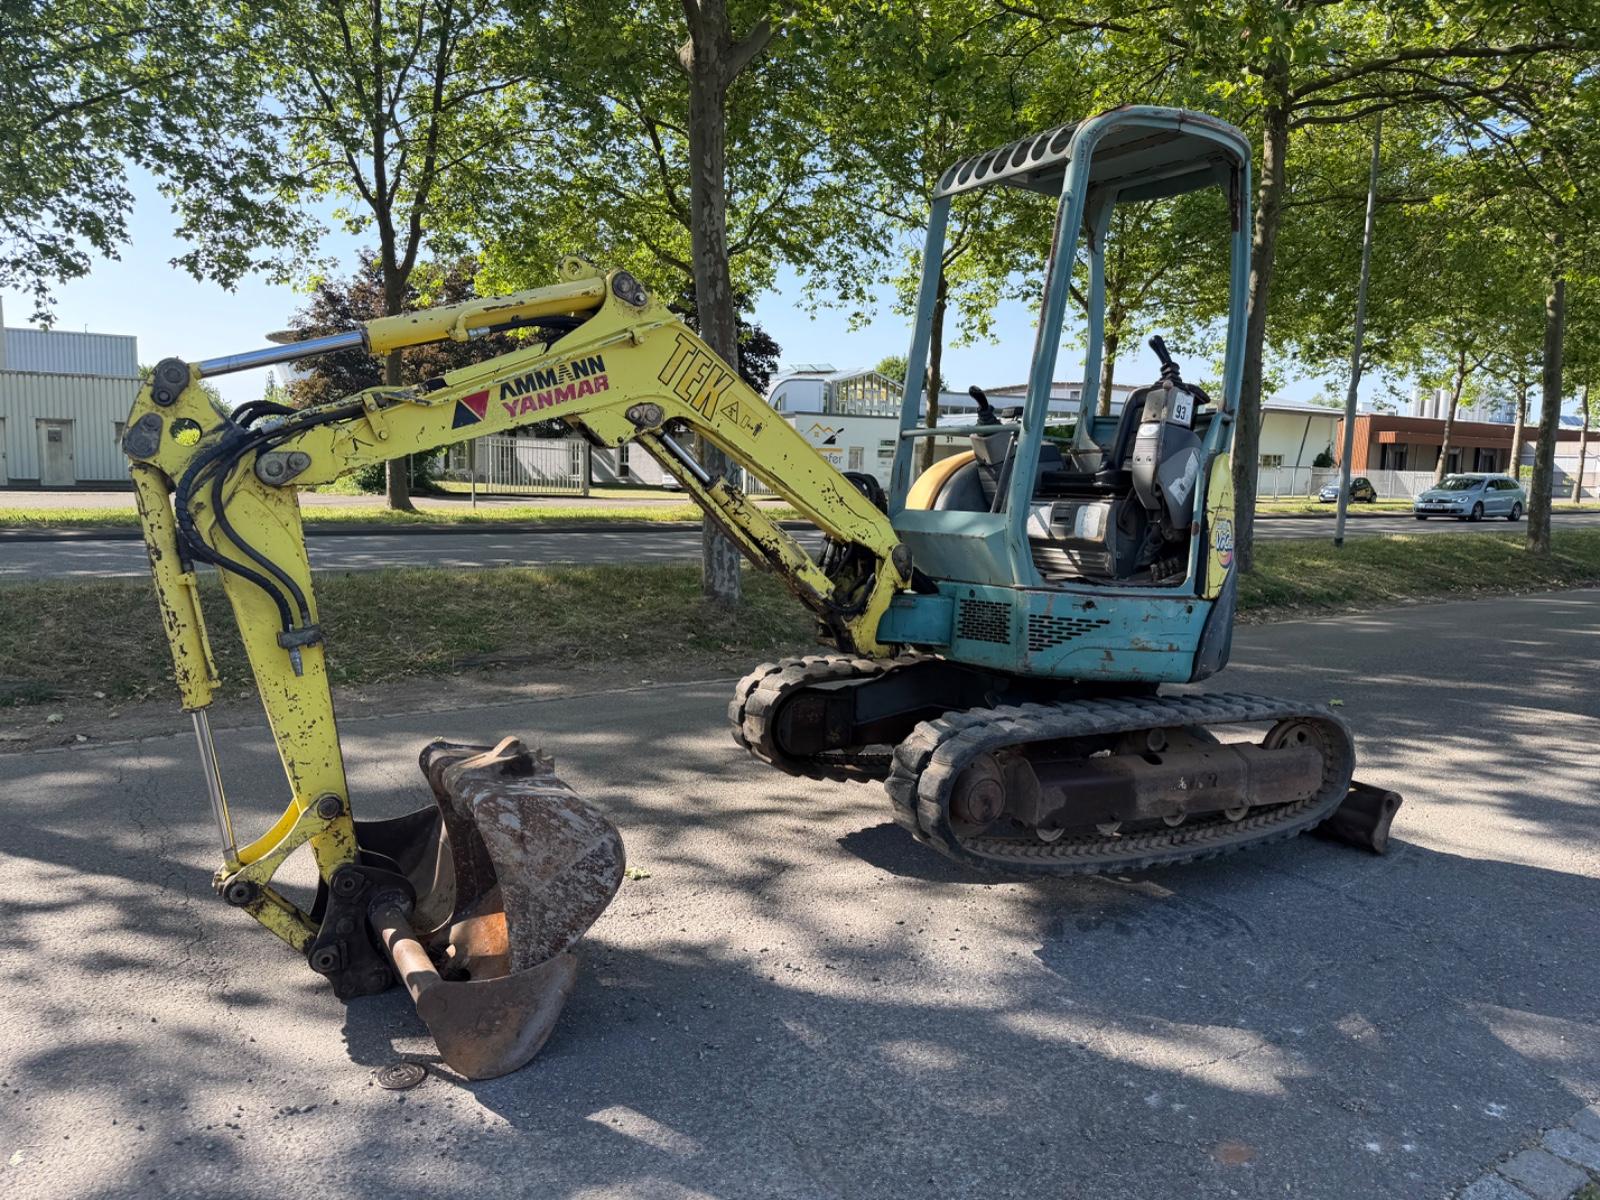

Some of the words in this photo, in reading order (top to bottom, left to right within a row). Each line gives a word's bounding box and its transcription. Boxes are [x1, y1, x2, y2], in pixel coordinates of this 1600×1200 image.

[500, 355, 605, 400] AMMANN
[502, 374, 609, 417] YANMAR
[658, 332, 735, 421] TEK
[1175, 404, 1187, 420] 93
